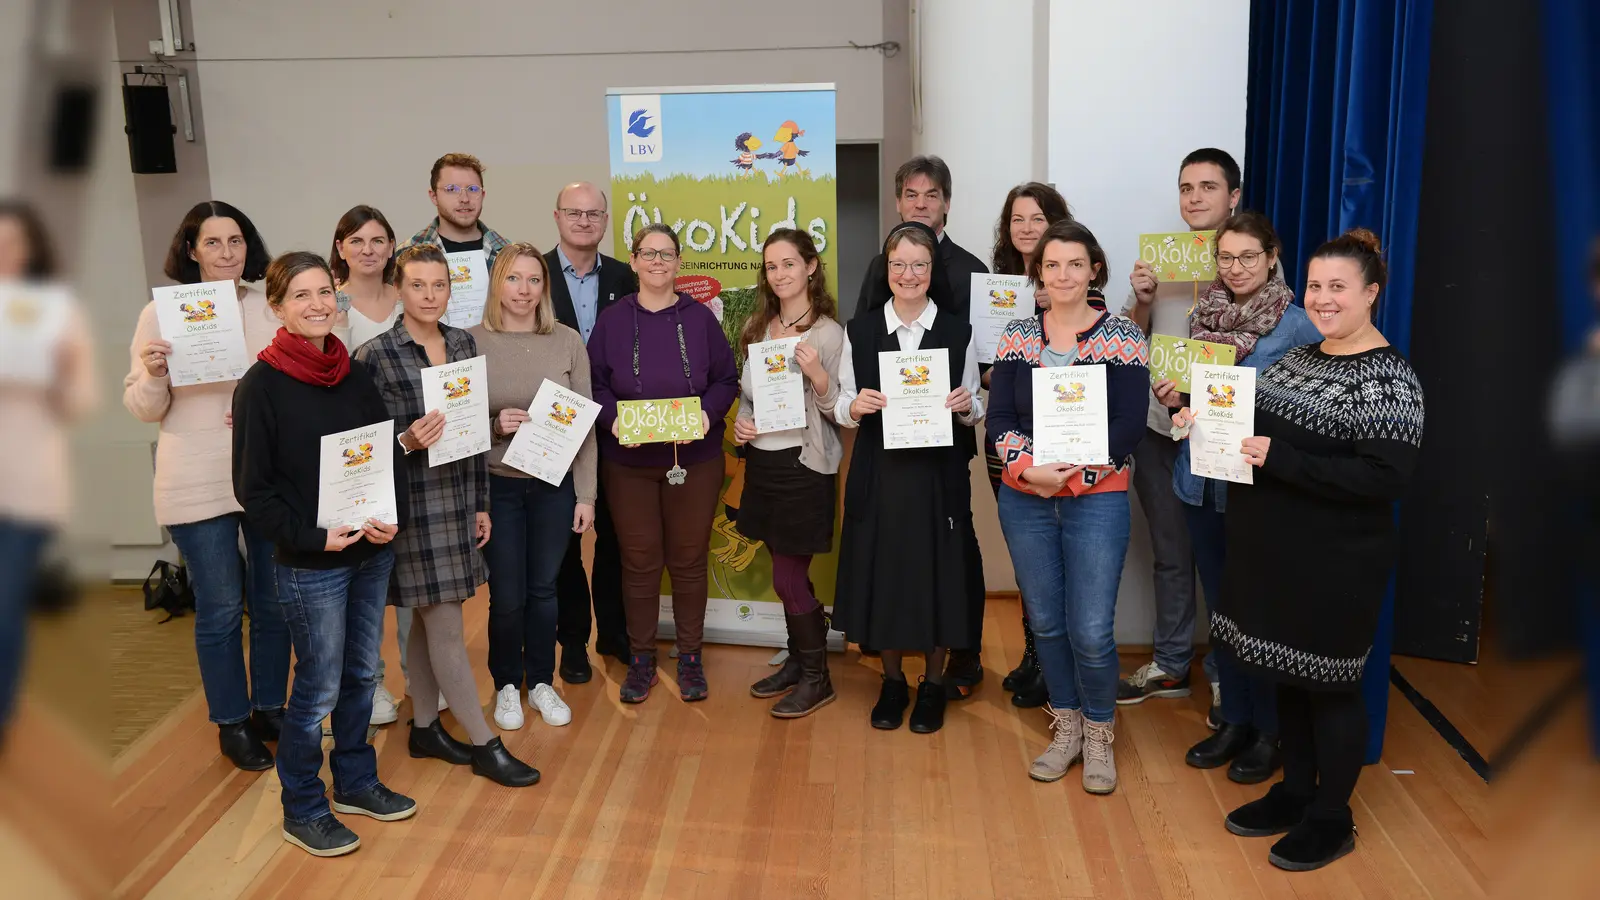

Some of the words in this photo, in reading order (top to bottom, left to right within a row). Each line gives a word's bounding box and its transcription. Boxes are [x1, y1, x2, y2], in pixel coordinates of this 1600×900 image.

[630, 144, 656, 155] LBV
[1142, 241, 1217, 264] ÖkoKid
[986, 278, 1021, 288] Zertifikat
[173, 288, 217, 300] Zertifikat
[761, 343, 788, 354] Zertifikat
[895, 355, 933, 364] Zertifikat
[438, 365, 473, 379] Zertifikat
[1049, 371, 1089, 380] Zertifikat
[1204, 370, 1240, 381] Zertifikat
[553, 389, 586, 409] Zertifikat
[620, 404, 699, 428] ÖkoKids
[339, 430, 378, 446] Zertifikat
